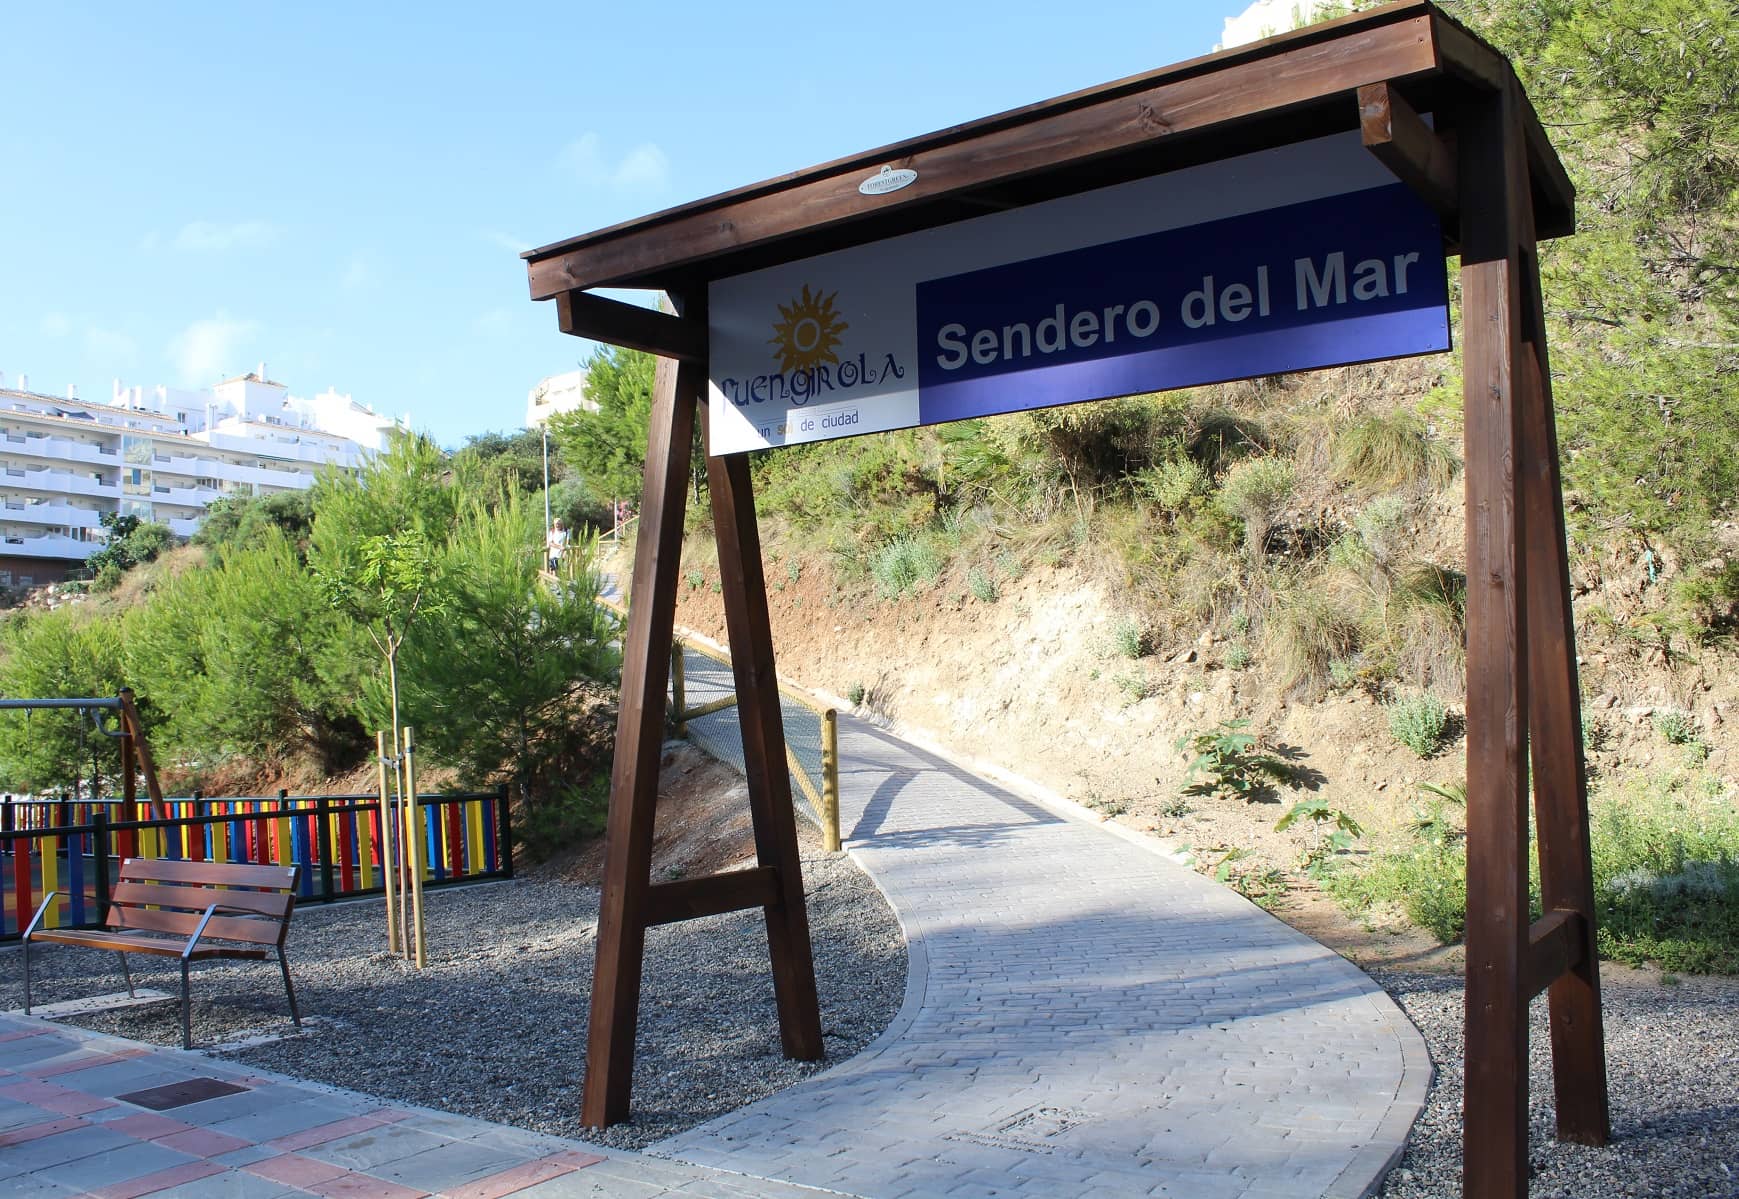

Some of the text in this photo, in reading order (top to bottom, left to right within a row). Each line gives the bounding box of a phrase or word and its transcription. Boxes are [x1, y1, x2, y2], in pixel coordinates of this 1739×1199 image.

[936, 250, 1420, 371] Sendero del Mar
[800, 418, 815, 432] de
[821, 410, 859, 429] ciudad
